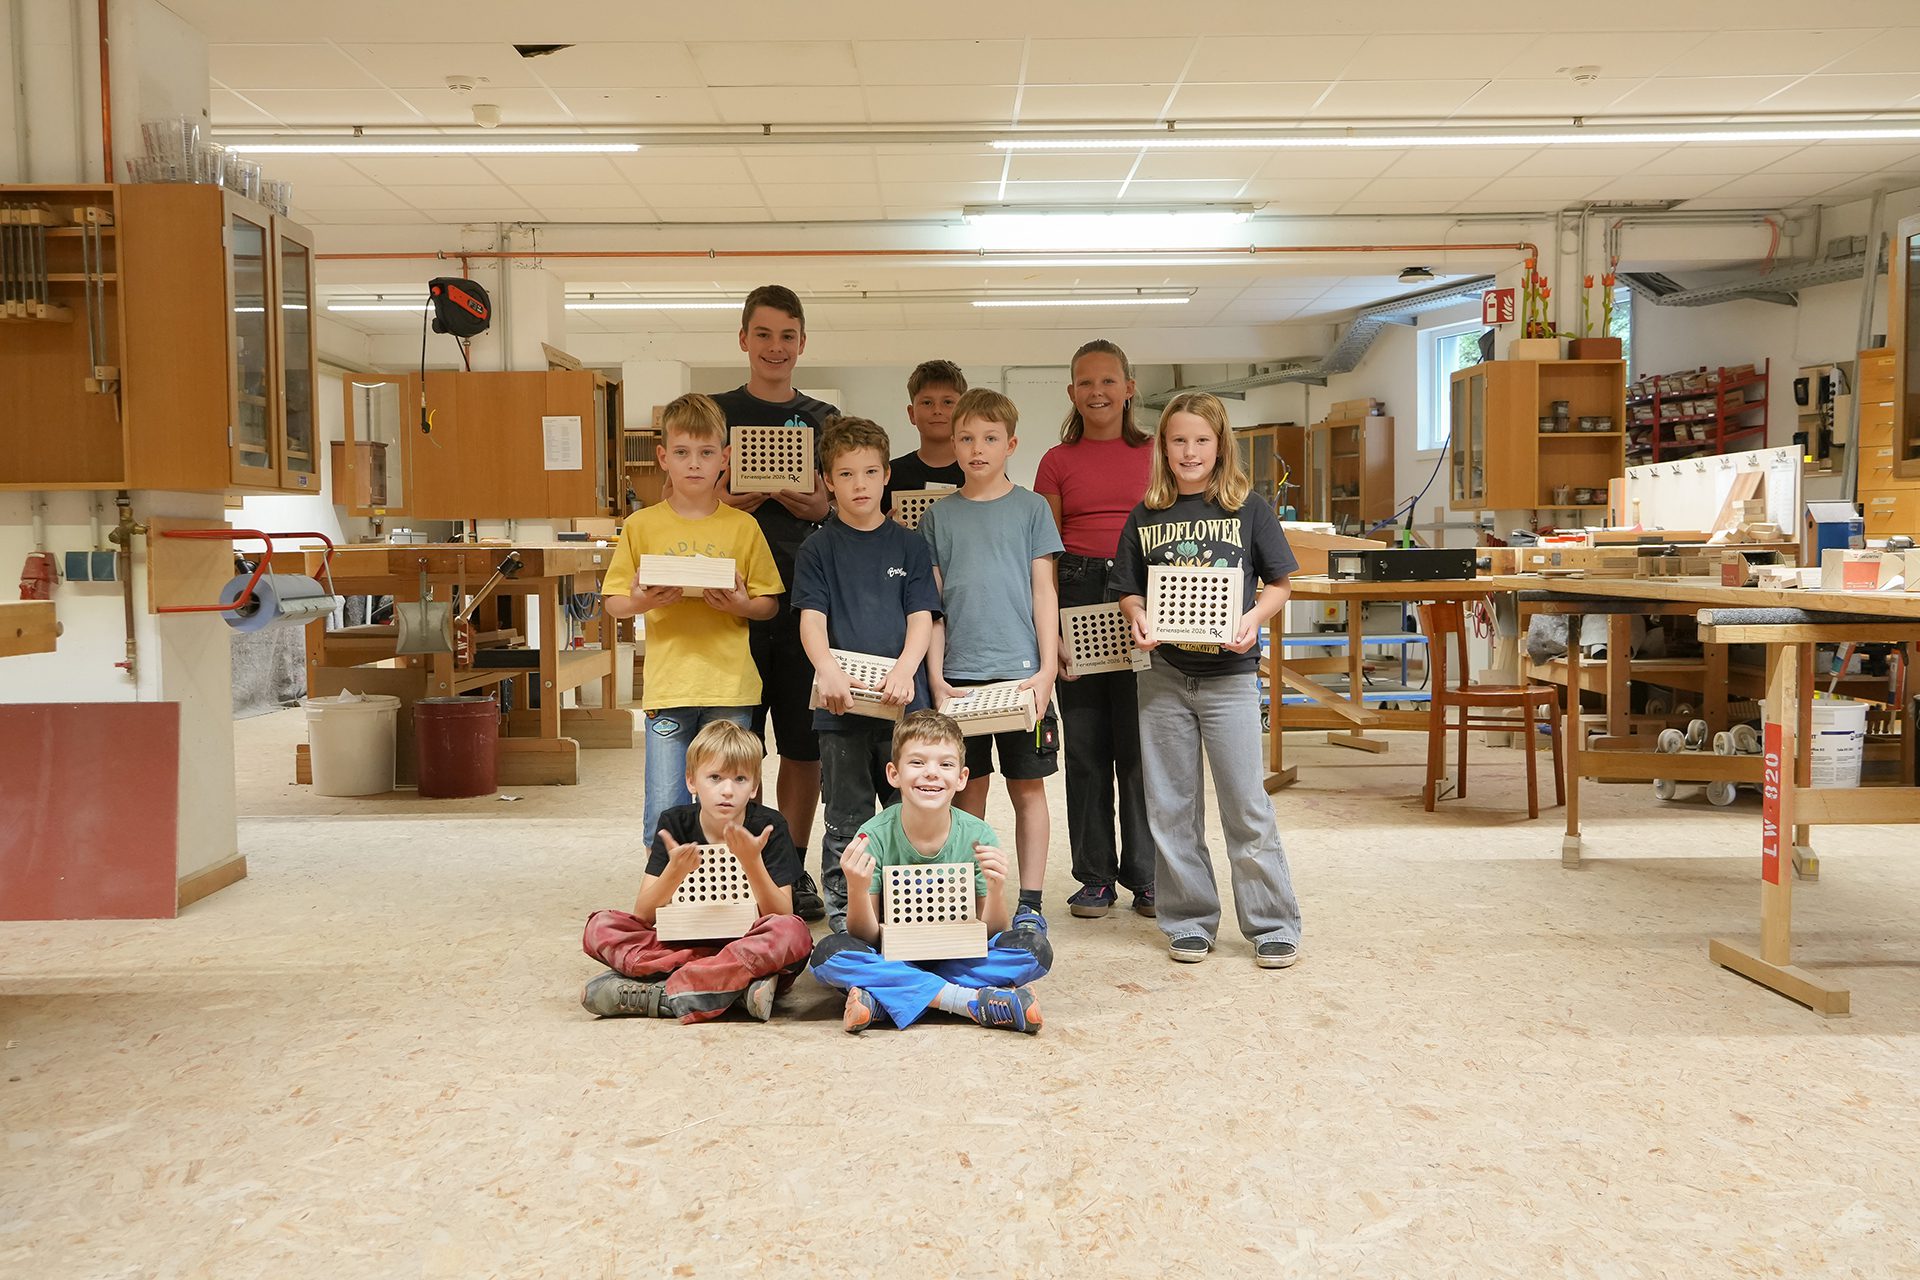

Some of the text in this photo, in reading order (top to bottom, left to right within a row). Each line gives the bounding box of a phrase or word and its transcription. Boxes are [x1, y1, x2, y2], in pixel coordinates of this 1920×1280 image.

[1138, 518, 1243, 557] WILDFLOWER
[1156, 626, 1191, 634] Ferienspiele
[1764, 753, 1779, 857] LW 820
